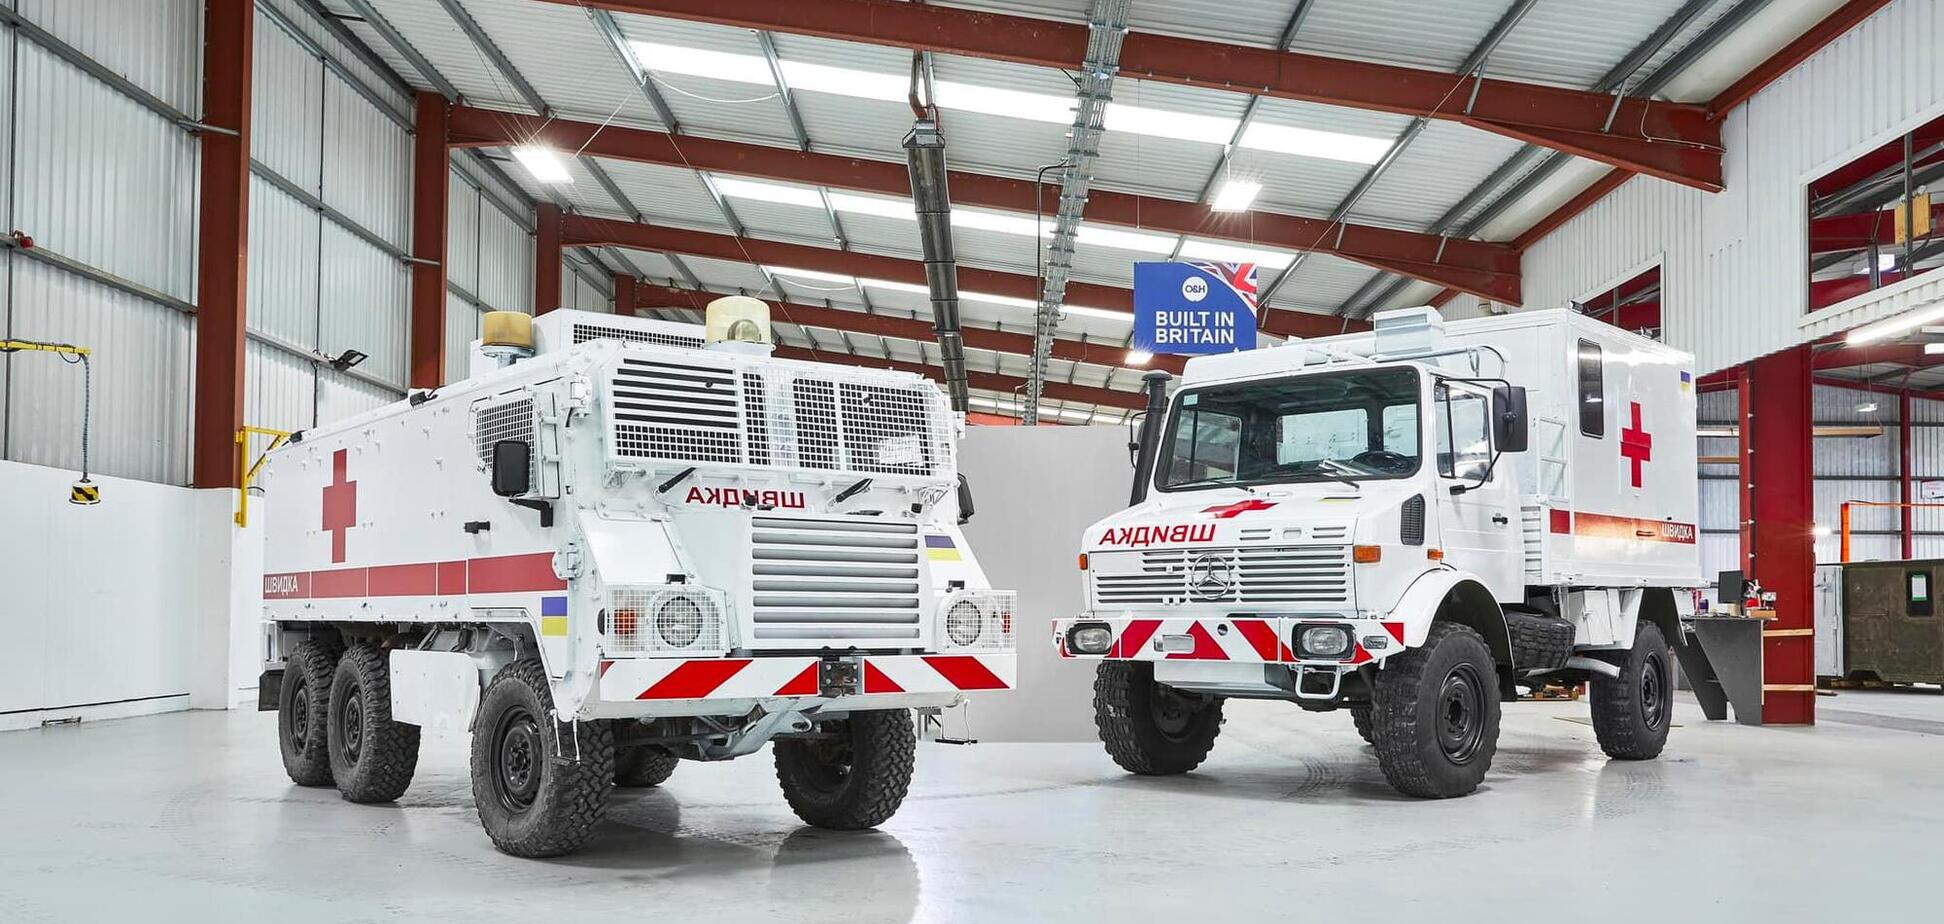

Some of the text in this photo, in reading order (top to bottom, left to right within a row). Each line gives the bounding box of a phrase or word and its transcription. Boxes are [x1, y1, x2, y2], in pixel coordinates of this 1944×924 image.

[1185, 285, 1206, 293] O&H
[1155, 311, 1234, 327] BUILT IN
[1155, 328, 1234, 344] BRITAIN
[1662, 523, 1693, 541] ШВИДКА
[264, 575, 299, 596] ШВИДКА
